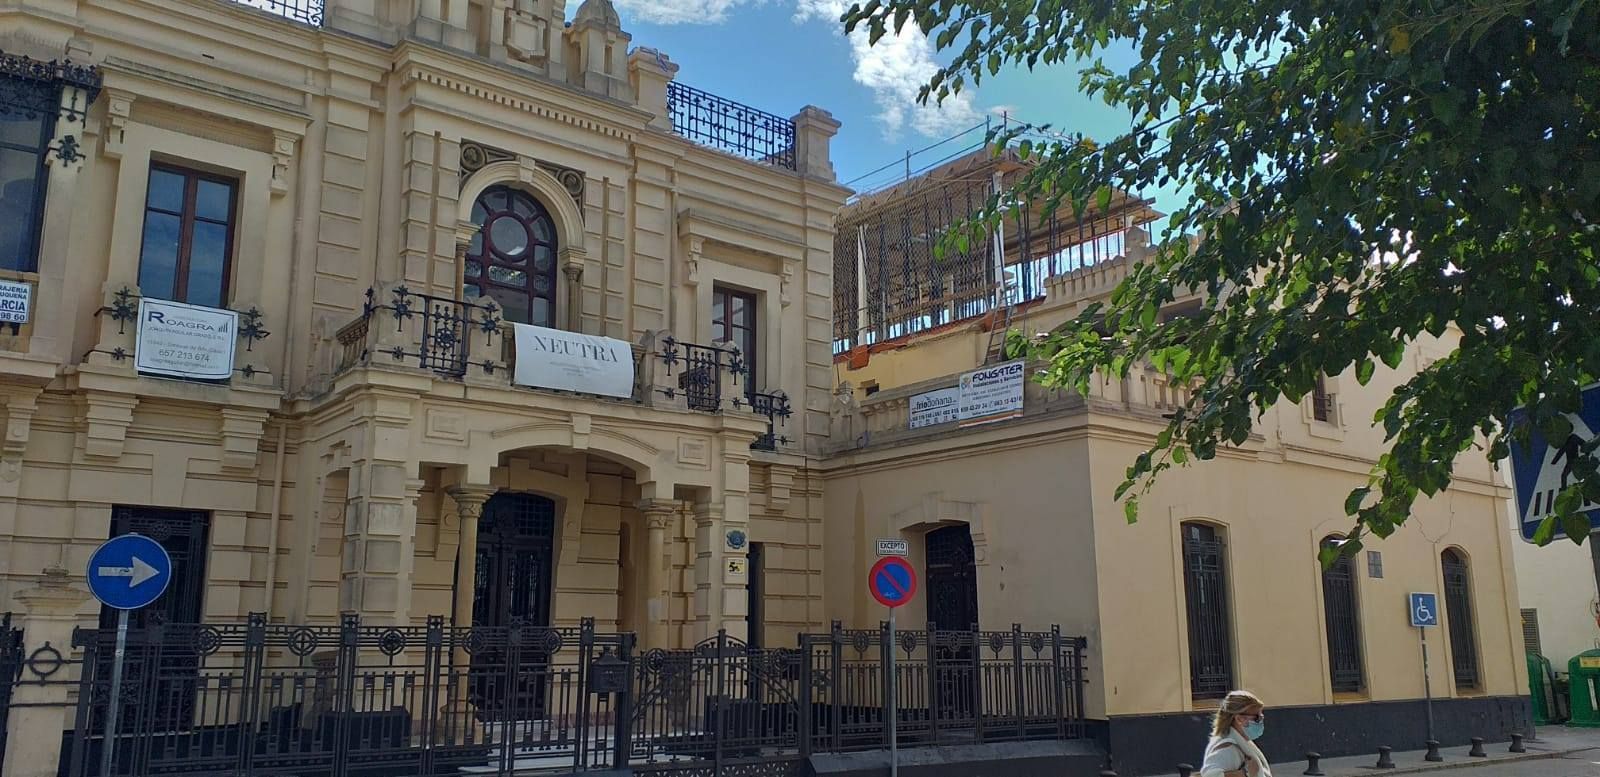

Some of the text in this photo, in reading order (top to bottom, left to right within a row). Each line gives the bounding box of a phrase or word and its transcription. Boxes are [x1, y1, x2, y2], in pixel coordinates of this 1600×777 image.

[0, 300, 25, 311] RCIA
[148, 311, 214, 331] ROAGRA
[177, 350, 193, 360] 213
[195, 353, 210, 362] 674
[534, 335, 618, 363] NEUTRA
[972, 364, 1023, 383] FONGATER
